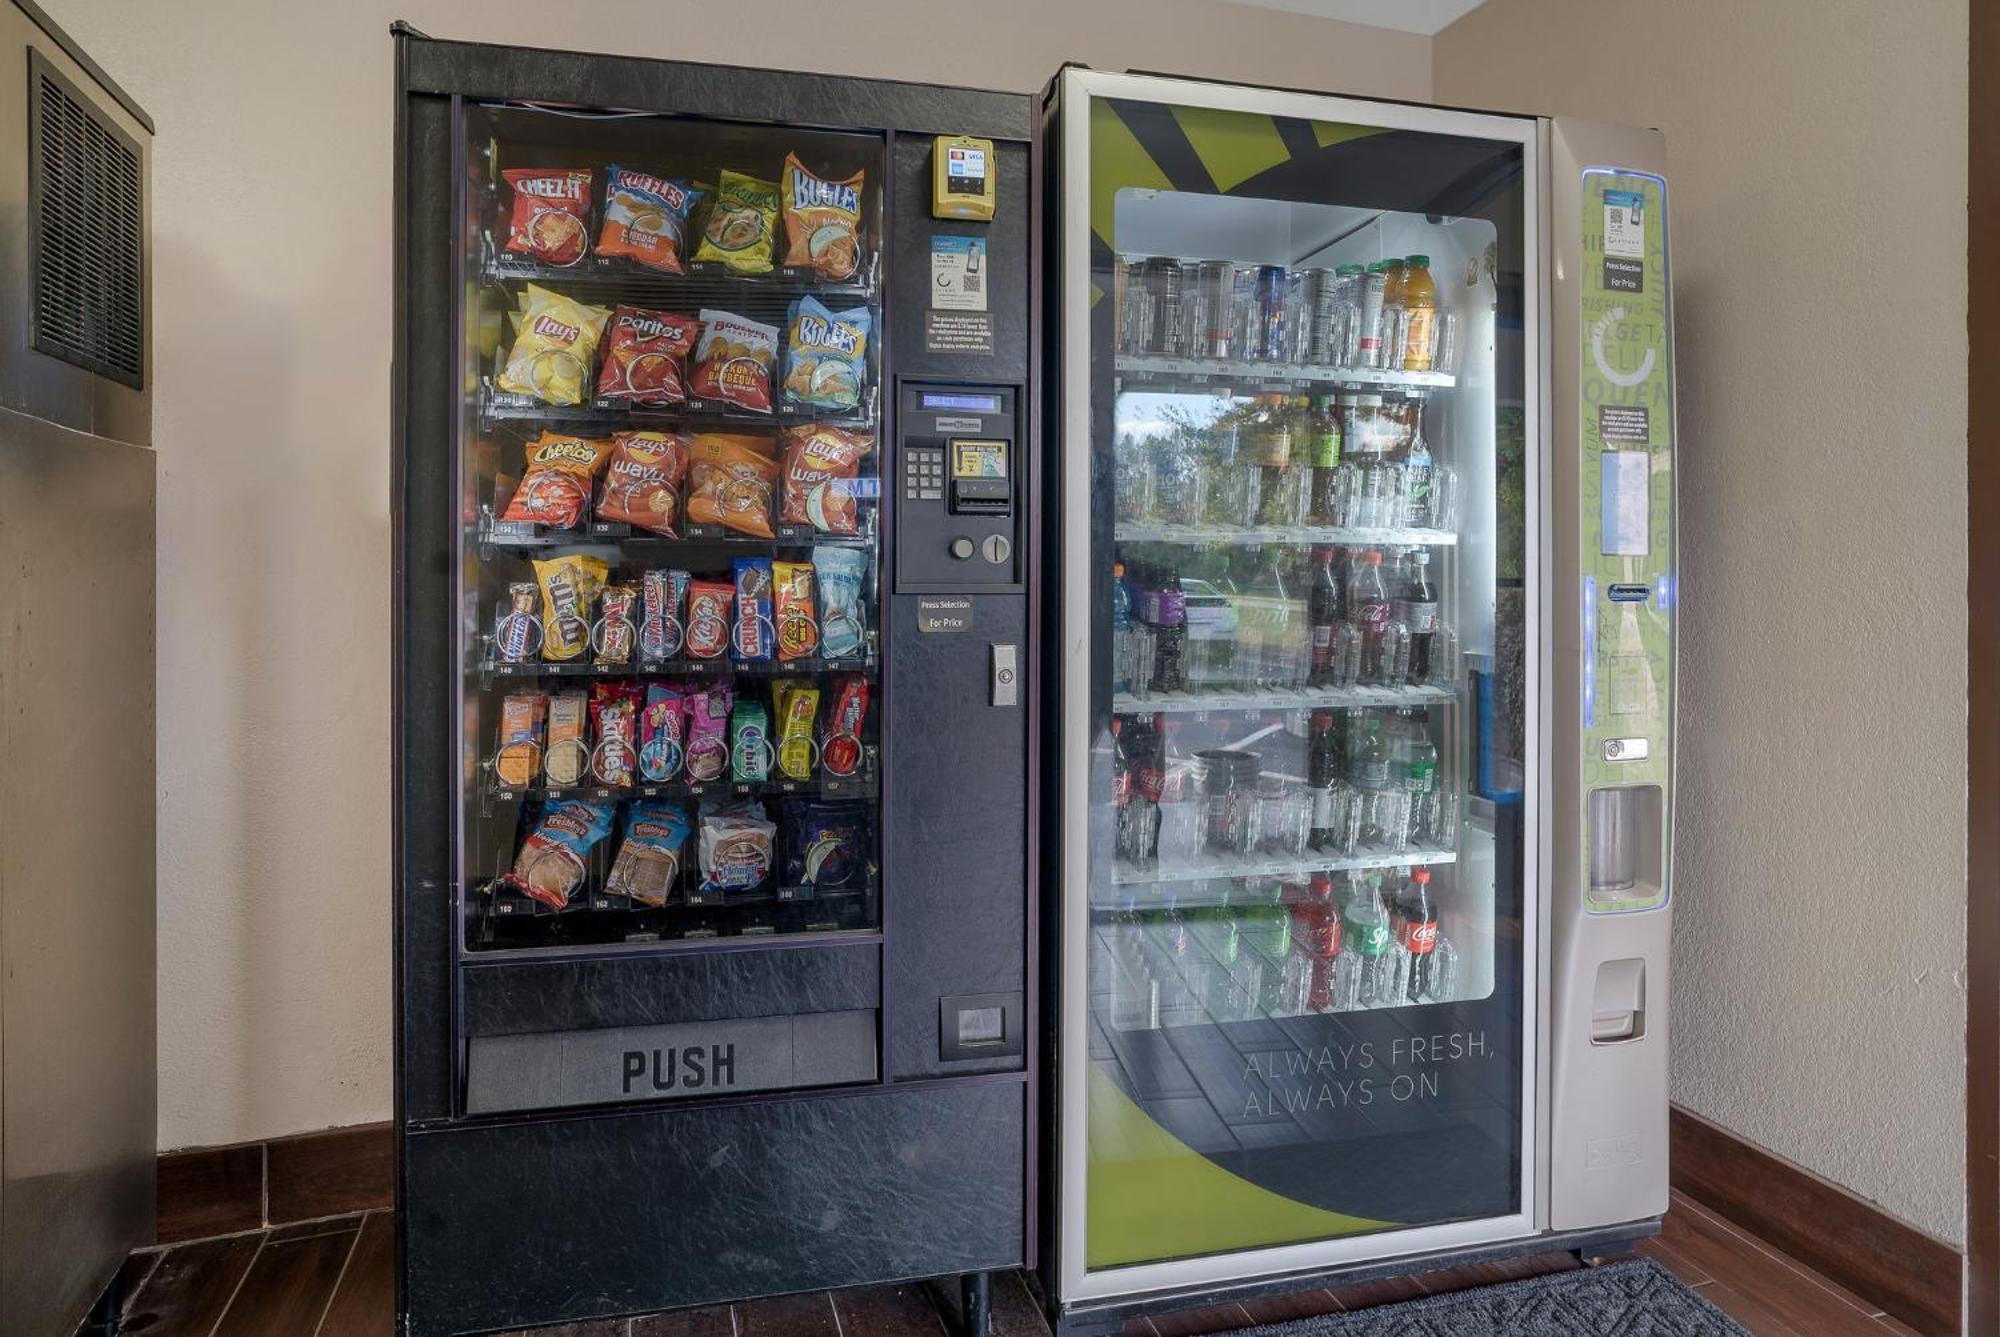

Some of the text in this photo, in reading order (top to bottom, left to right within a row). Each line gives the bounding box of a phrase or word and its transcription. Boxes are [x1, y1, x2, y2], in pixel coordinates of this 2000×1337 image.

[618, 169, 685, 210] RUFFLES
[1611, 279, 1637, 289] For Price
[619, 315, 683, 340] Doritos
[533, 440, 598, 466] Cheetos
[921, 600, 970, 609] Press Selection
[930, 618, 963, 628] For Price
[740, 596, 758, 655] CRUNCH
[600, 705, 624, 784] Skittles
[623, 1043, 735, 1093] PUSH
[1242, 1030, 1495, 1081] ALWAYS FRESH,
[1242, 1071, 1439, 1119] ALWAYS ON
